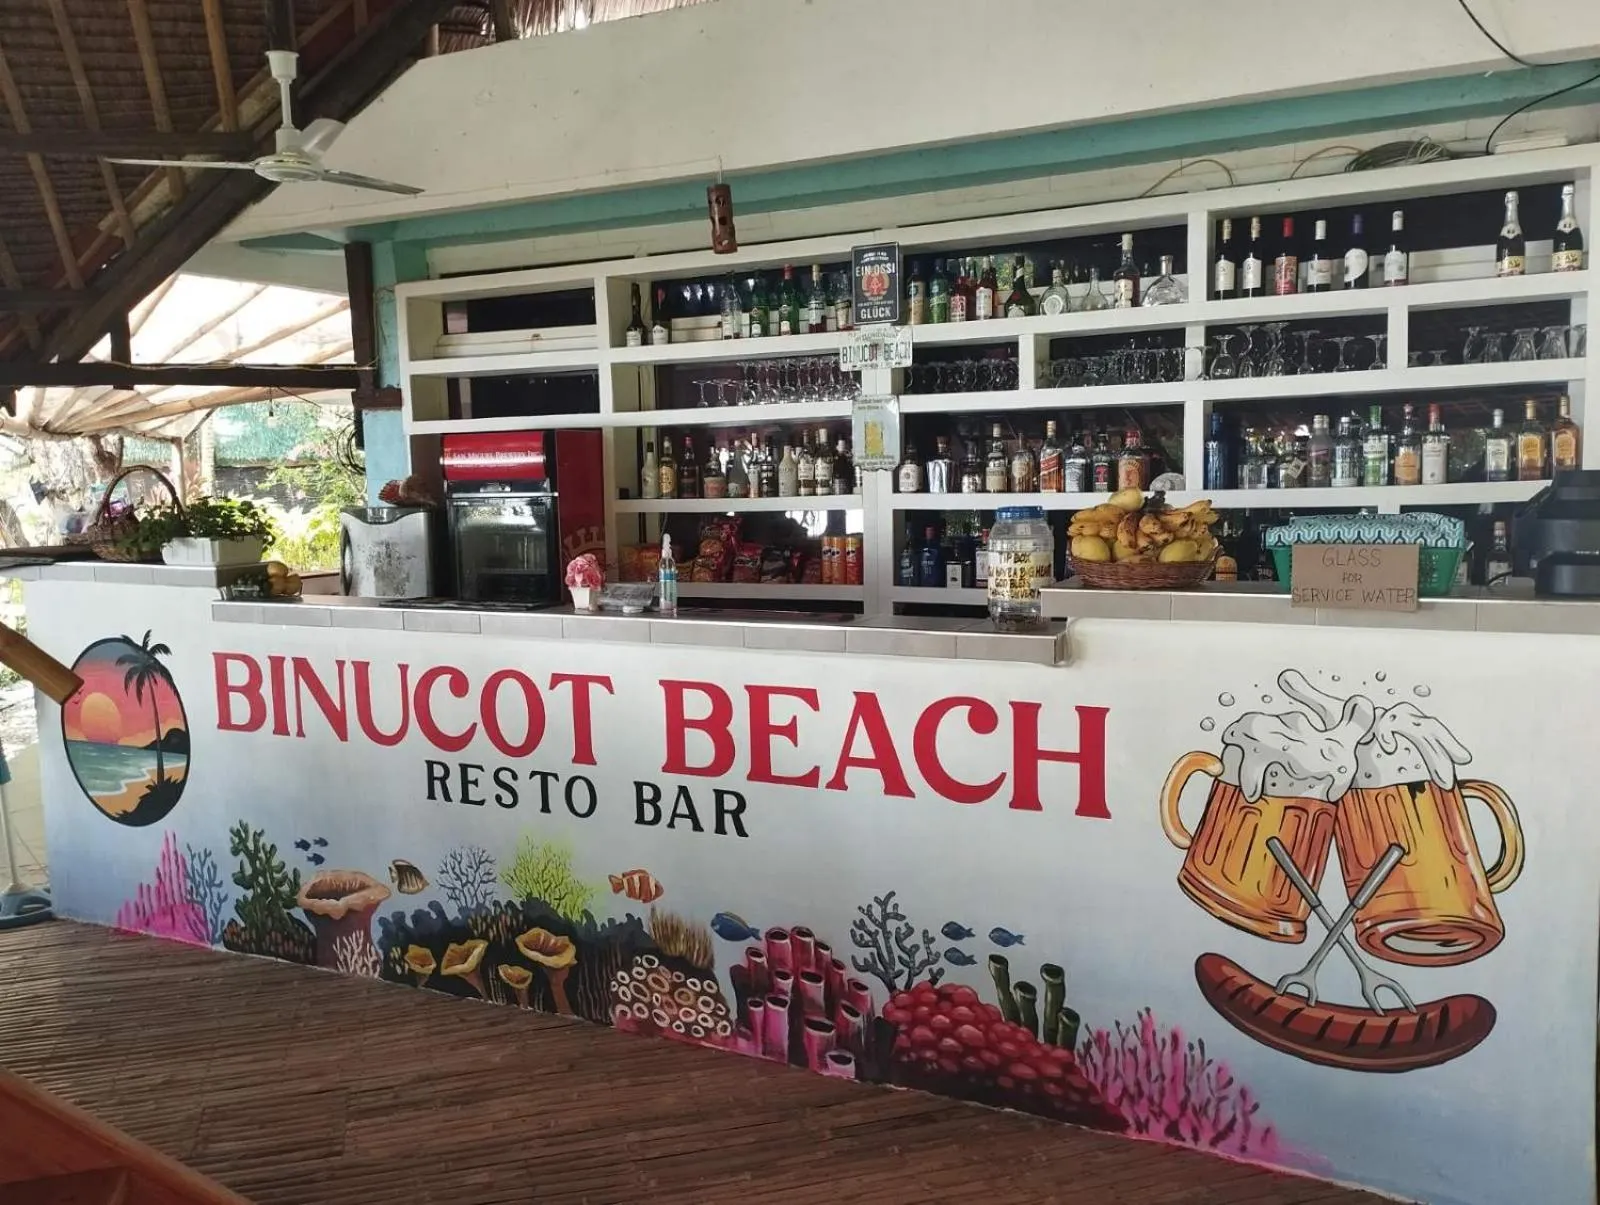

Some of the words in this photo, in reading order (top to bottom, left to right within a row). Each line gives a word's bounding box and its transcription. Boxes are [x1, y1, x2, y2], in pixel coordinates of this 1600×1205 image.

[860, 306, 892, 320] GLÜCK
[1014, 552, 1031, 563] BOX
[1321, 548, 1381, 568] GLASS
[995, 578, 1008, 587] GOD
[1009, 578, 1031, 589] BLESS
[1341, 571, 1363, 584] FOR
[1291, 588, 1356, 605] SERVICE
[1361, 586, 1416, 604] WATER
[212, 651, 614, 766] BINUCOT
[658, 678, 1112, 820] BEACH
[424, 759, 598, 819] RESTO
[633, 780, 750, 838] BAR
